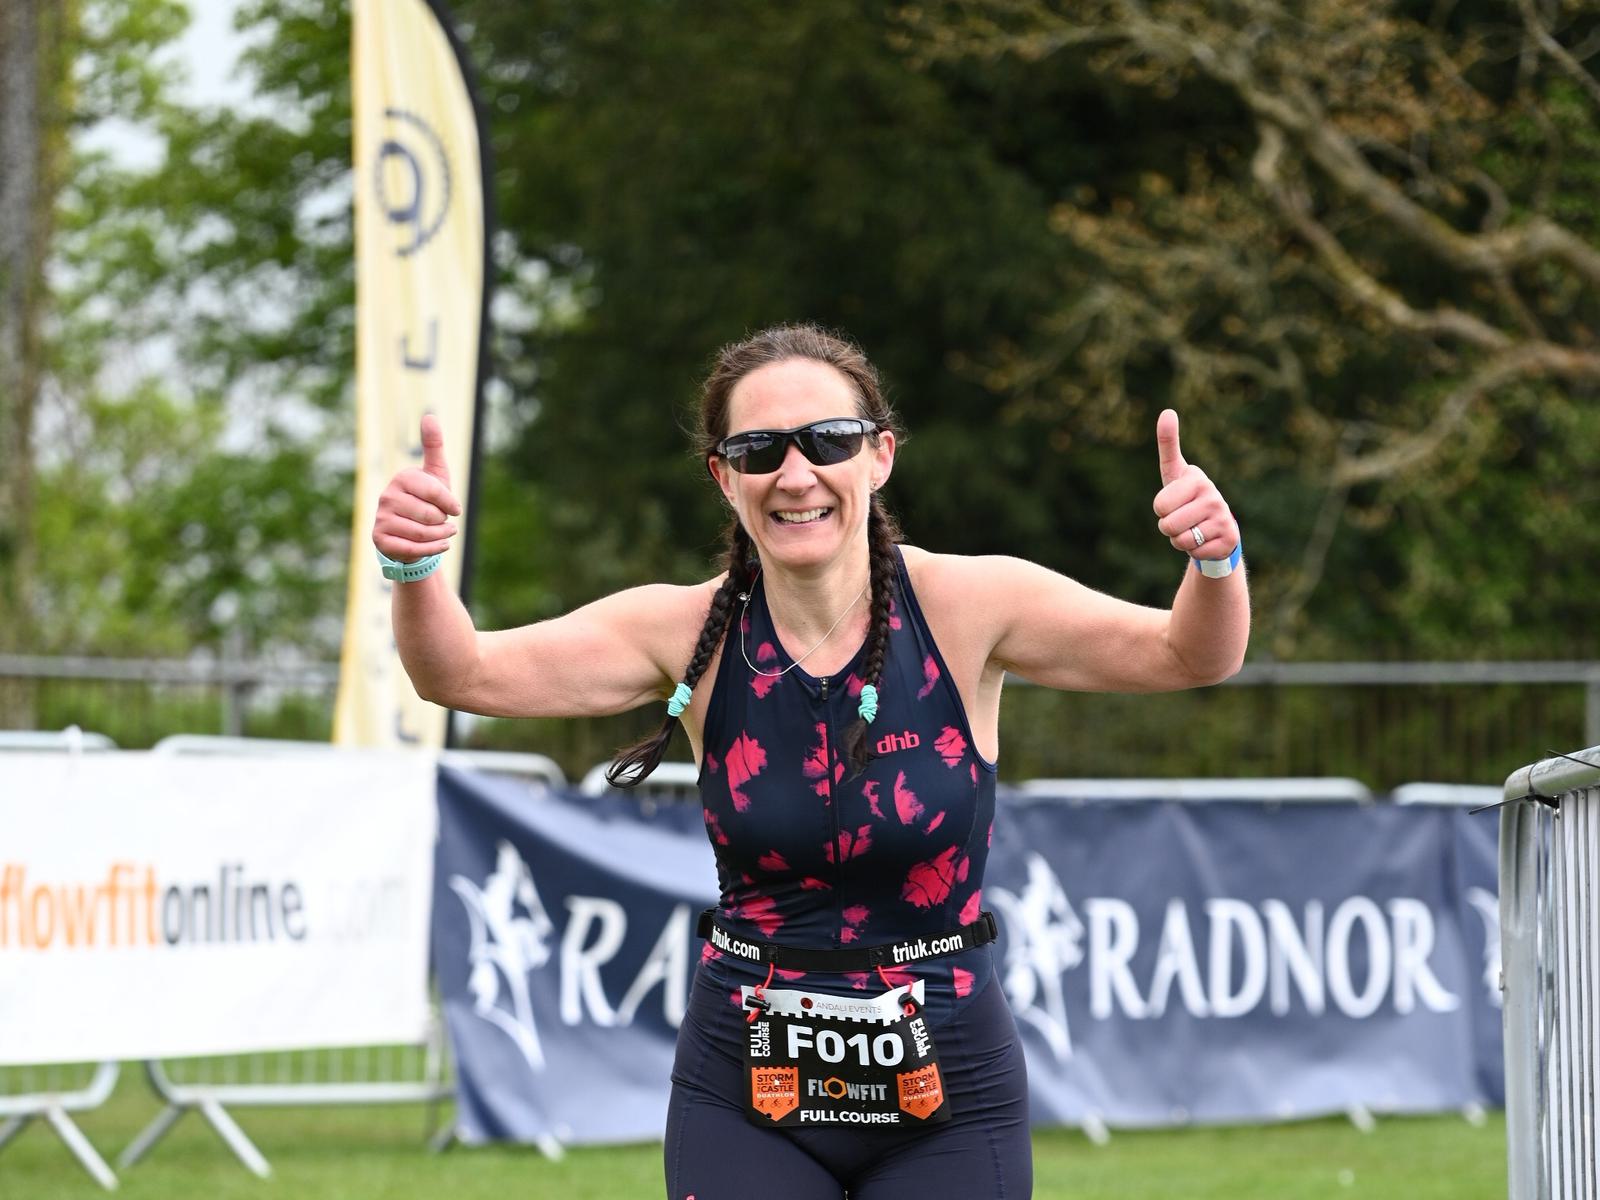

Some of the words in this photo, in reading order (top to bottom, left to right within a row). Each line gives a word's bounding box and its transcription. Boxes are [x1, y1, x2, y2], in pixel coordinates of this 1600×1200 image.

[876, 730, 920, 755] dhb
[893, 934, 963, 963] triuk.com
[1085, 896, 1460, 1019] RADNOR
[848, 1005, 882, 1014] EVENTS
[750, 1022, 762, 1057] FULL
[761, 1022, 770, 1057] COURSE
[787, 1024, 905, 1067] F010
[757, 1073, 794, 1083] STORM
[902, 1072, 935, 1087] STORM
[761, 1084, 794, 1093] CASTLE
[907, 1083, 937, 1095] CASTLE
[800, 1110, 839, 1122] FULL
[839, 1111, 900, 1123] COURSE
